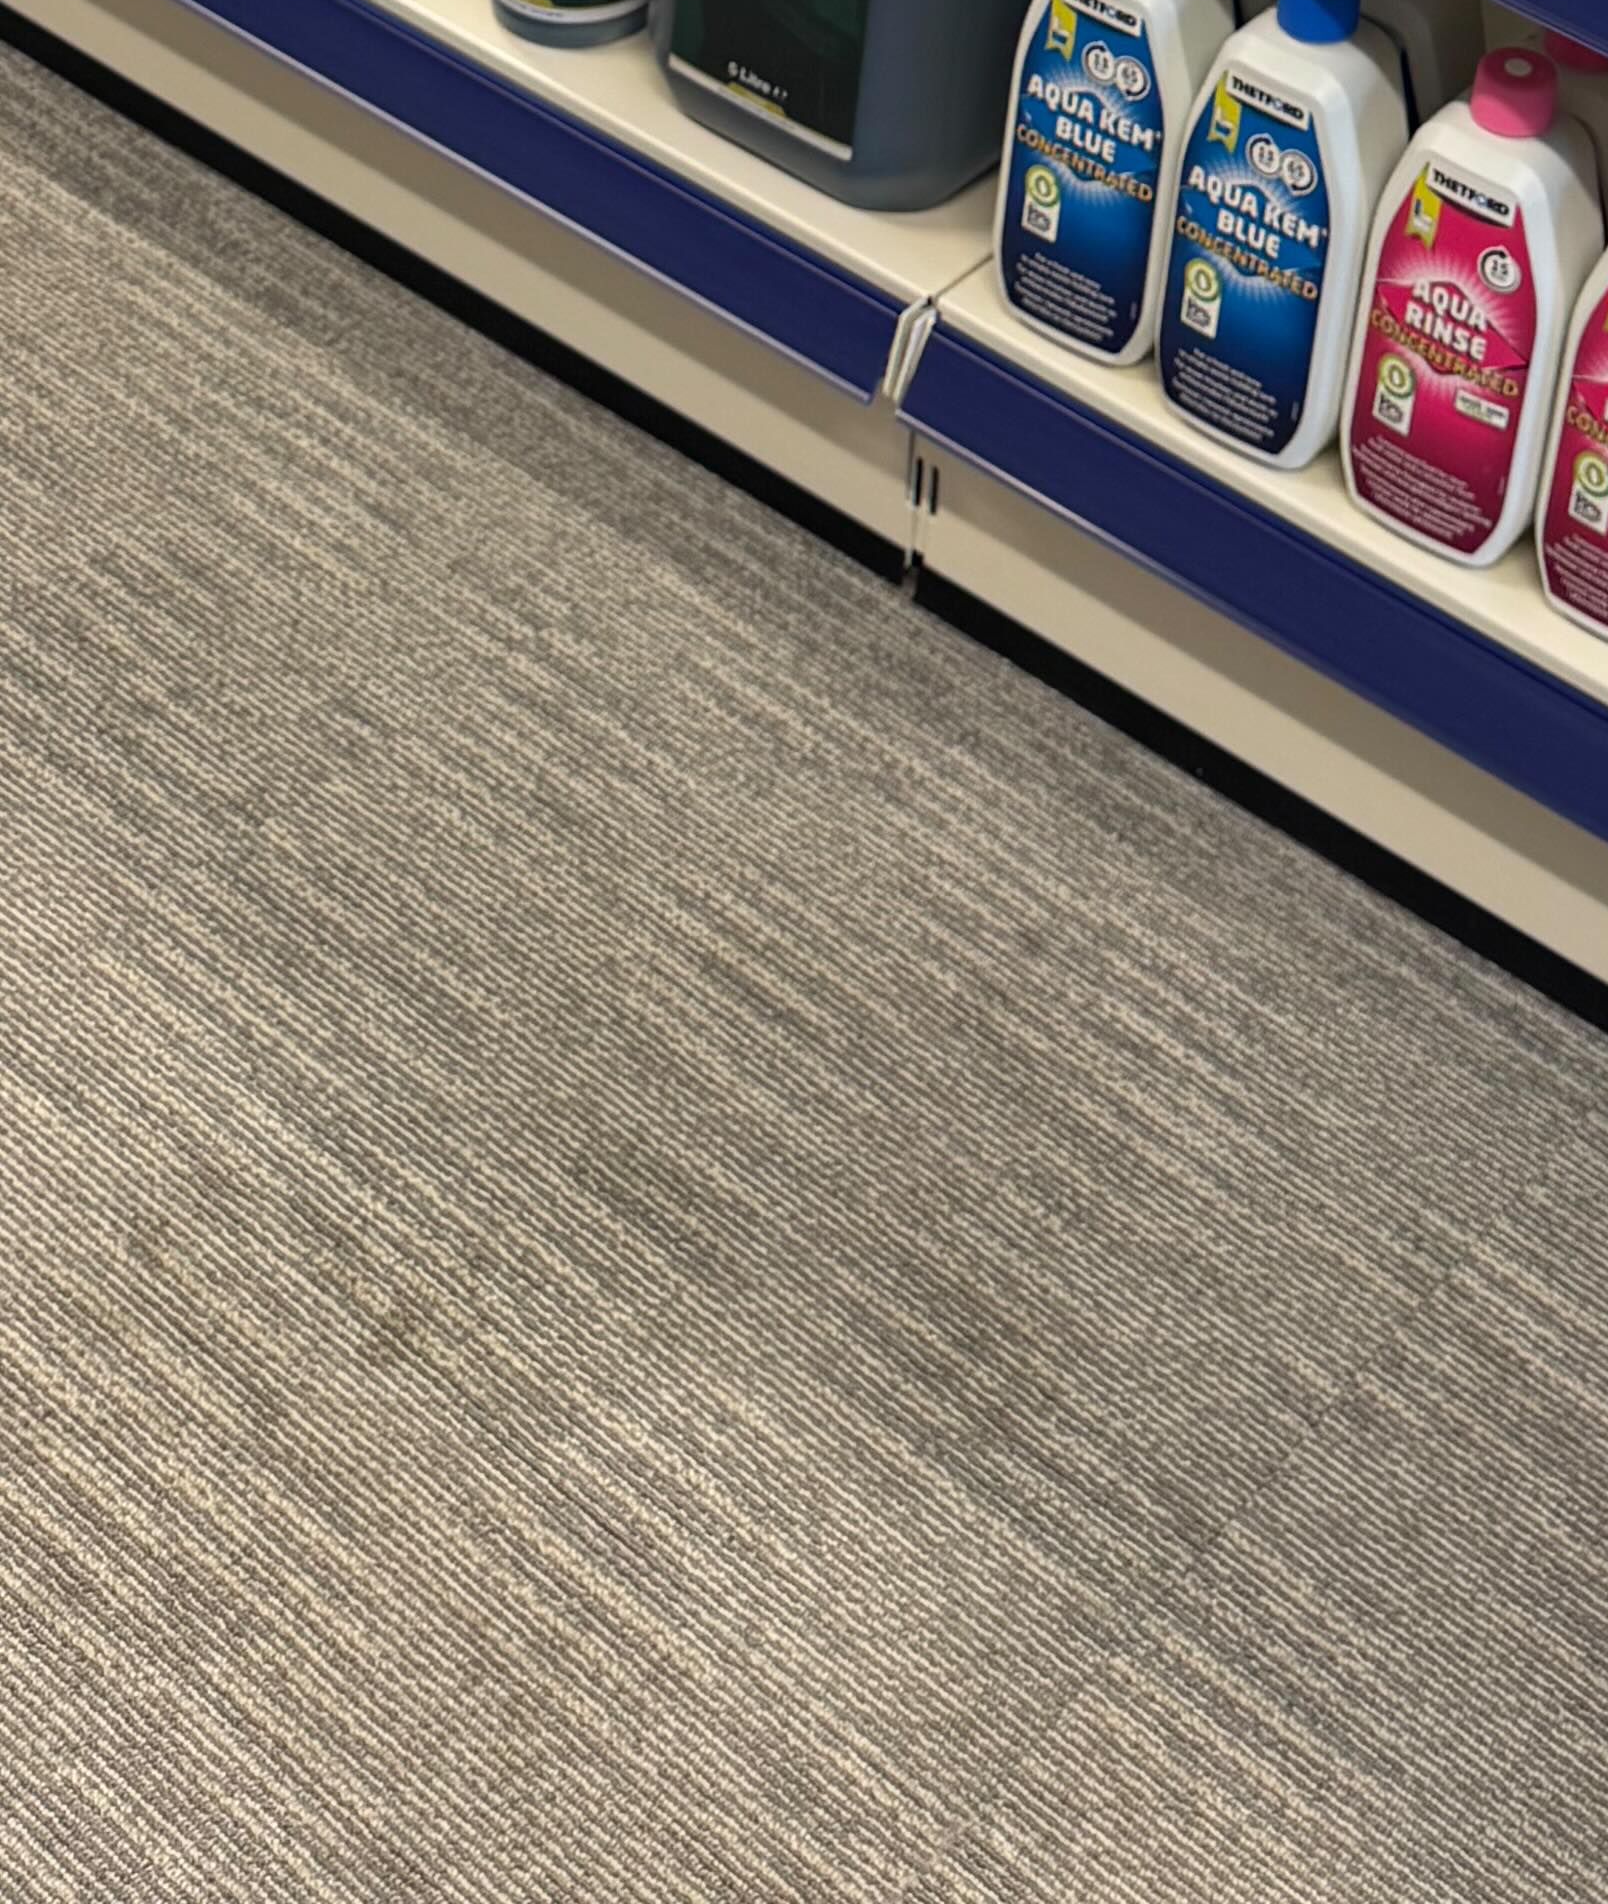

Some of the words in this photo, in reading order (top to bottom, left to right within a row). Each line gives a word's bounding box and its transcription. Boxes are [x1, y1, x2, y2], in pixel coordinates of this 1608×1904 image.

[1027, 73, 1095, 124] AQUA
[1099, 110, 1155, 151] KEM
[1056, 116, 1117, 163] BLUE
[1016, 124, 1153, 202] CONCENTRATED
[1432, 168, 1510, 218] THETFORD
[1404, 301, 1487, 361] RINSE
[1412, 278, 1488, 332] AQUA
[1371, 309, 1518, 398] CONCENTRATED
